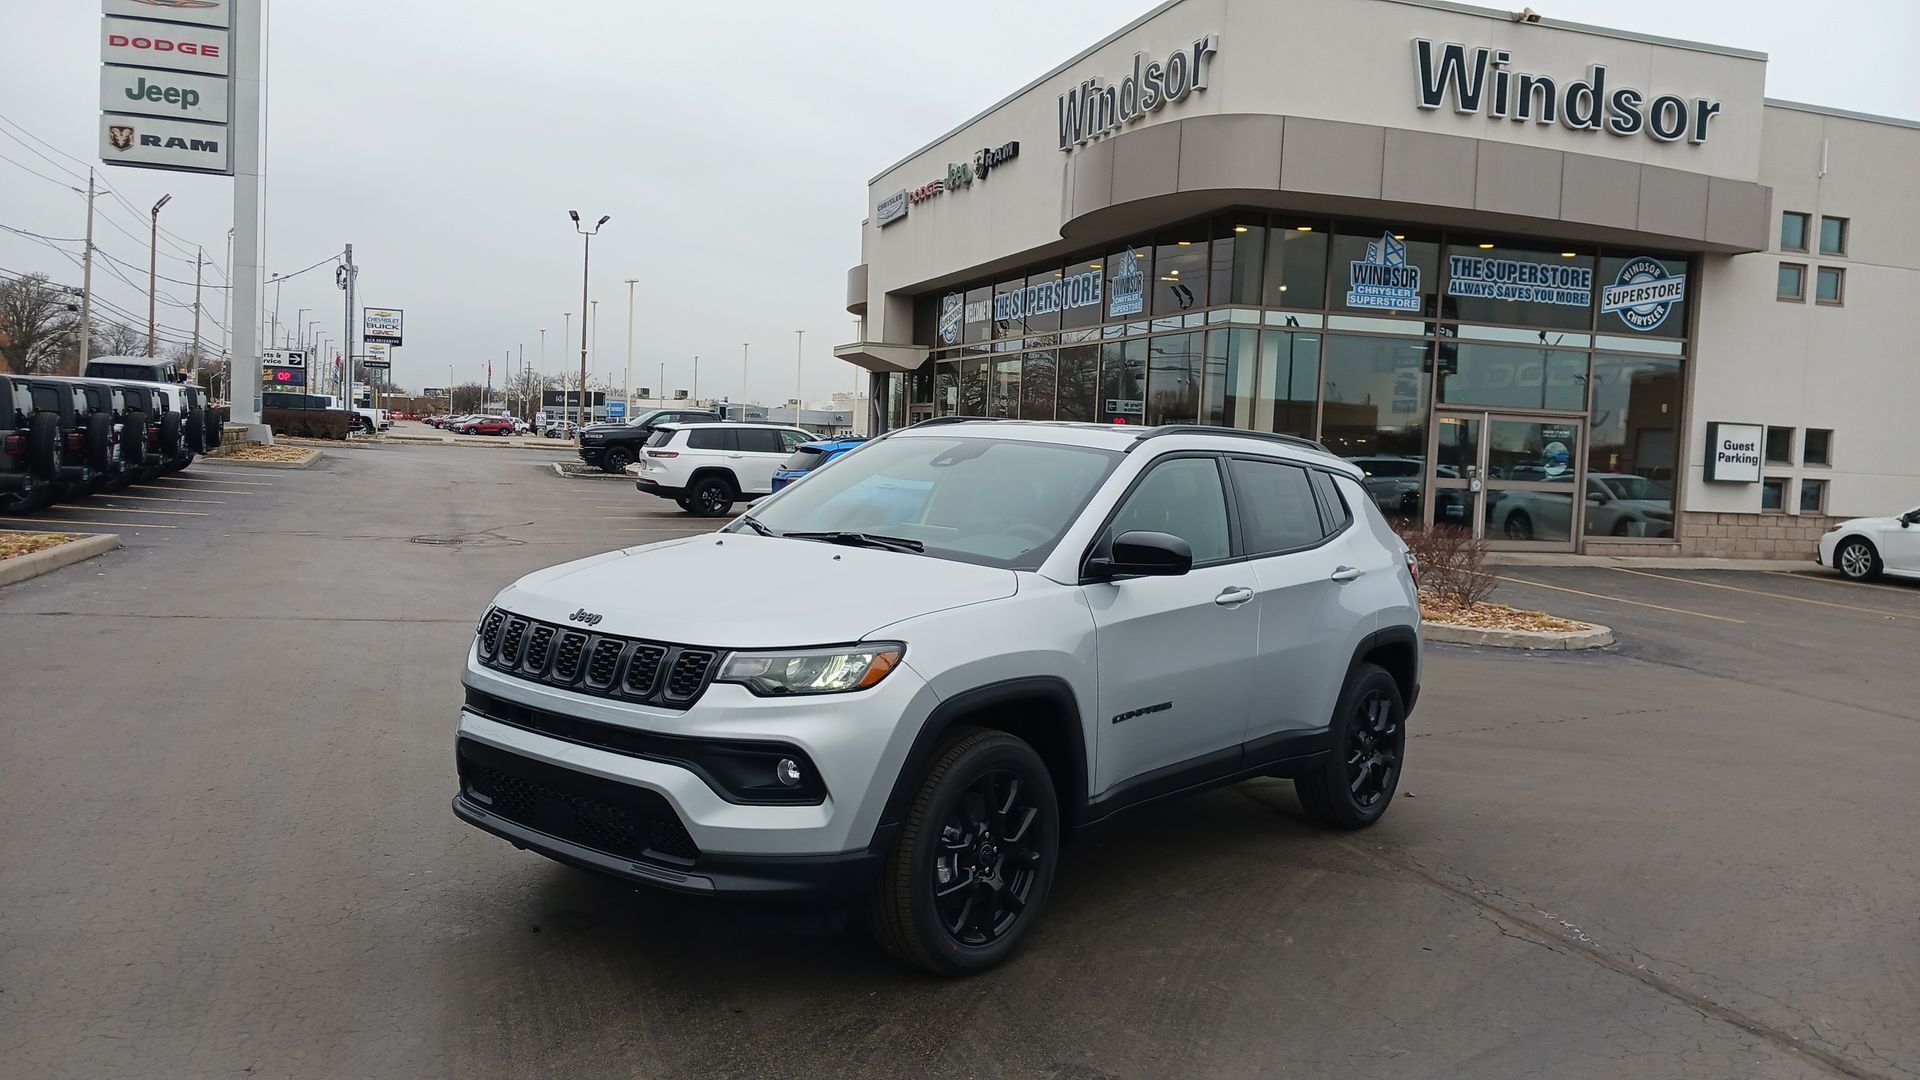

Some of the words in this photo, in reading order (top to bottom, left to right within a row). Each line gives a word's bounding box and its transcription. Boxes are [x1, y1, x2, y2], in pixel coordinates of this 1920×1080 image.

[109, 35, 219, 57] DODGE
[125, 77, 200, 109] Jeep
[1057, 33, 1218, 152] Windsor
[1411, 37, 1721, 145] Windsor
[140, 134, 218, 153] RAM
[984, 141, 1020, 168] RAM
[877, 193, 903, 212] CHRYSLER
[908, 179, 943, 204] DODGE
[1352, 263, 1418, 289] WINDSOR
[1451, 257, 1482, 277] THE
[1484, 260, 1591, 288] SUPERSTORE
[1622, 262, 1661, 281] WINDSOR
[995, 295, 1010, 320] THE
[1012, 272, 1101, 318] SUPERSTORE
[1349, 295, 1418, 308] SUPERSTORE
[1357, 286, 1411, 297] CHRYSLER
[1450, 281, 1494, 296] ALWAYS
[1496, 284, 1531, 300] SAVES
[1534, 287, 1554, 302] YOU
[1555, 290, 1589, 305] MORE!
[1605, 282, 1681, 306] SUPERSTORE
[1626, 305, 1665, 326] CHRYSLER
[1723, 440, 1755, 452] Guest
[1718, 452, 1758, 466] Parking
[569, 608, 603, 626] Jeep
